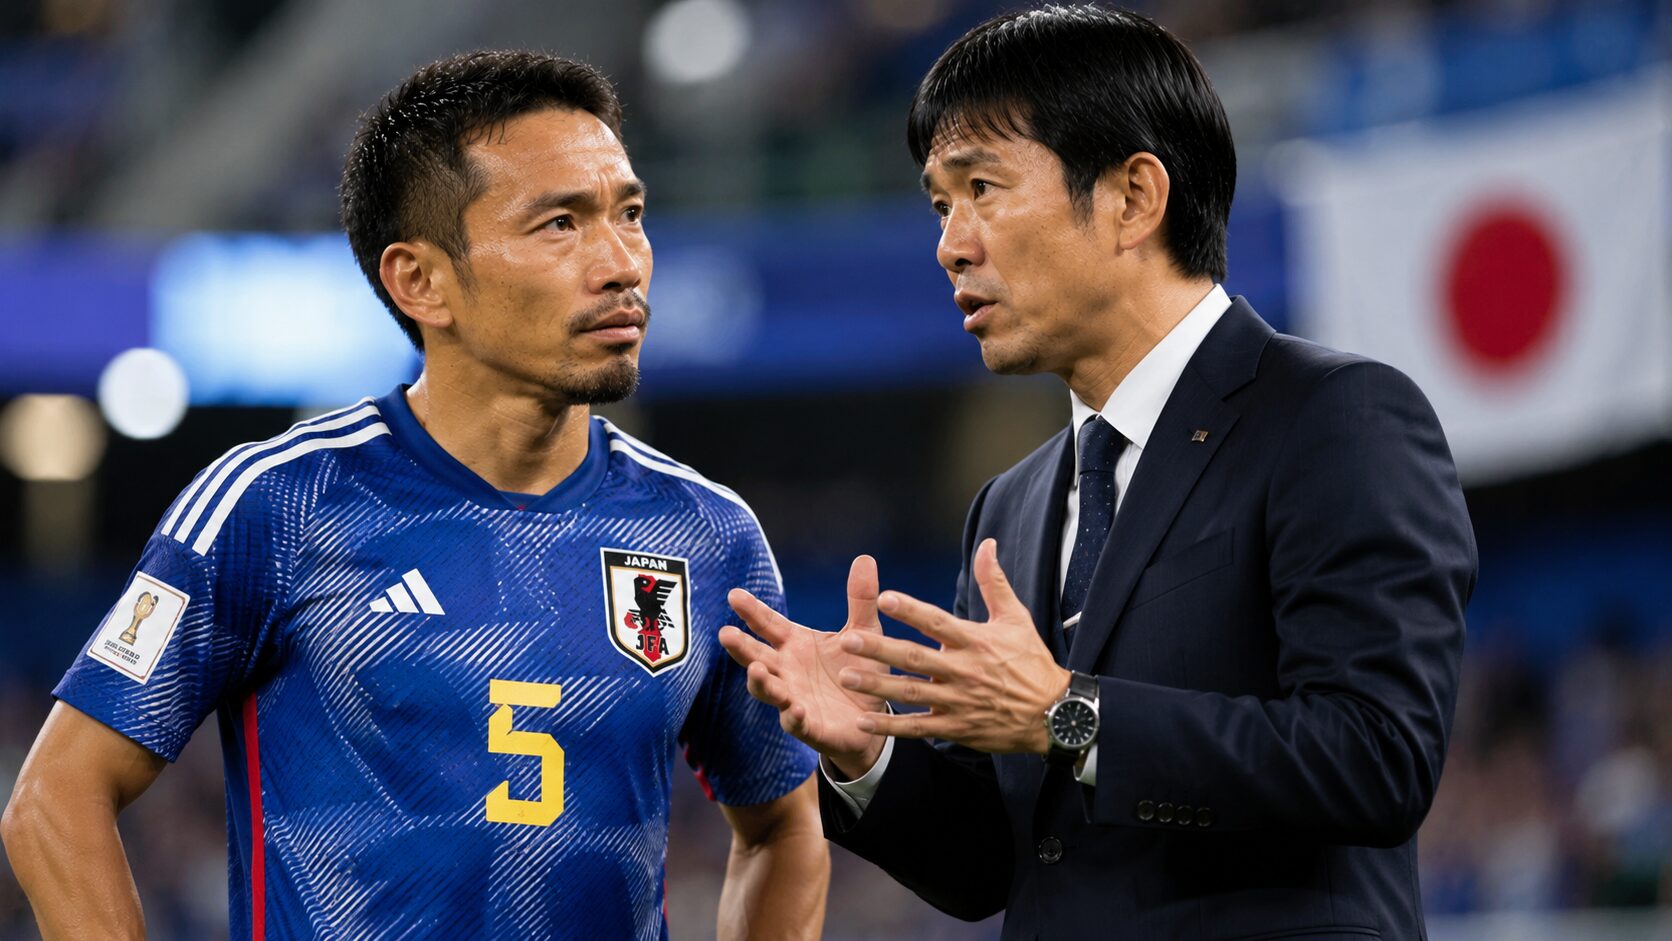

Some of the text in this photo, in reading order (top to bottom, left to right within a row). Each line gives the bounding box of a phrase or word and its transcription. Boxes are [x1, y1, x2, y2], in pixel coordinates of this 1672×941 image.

[624, 555, 668, 571] JAPAN
[635, 634, 669, 656] JFA
[486, 678, 565, 827] 5
